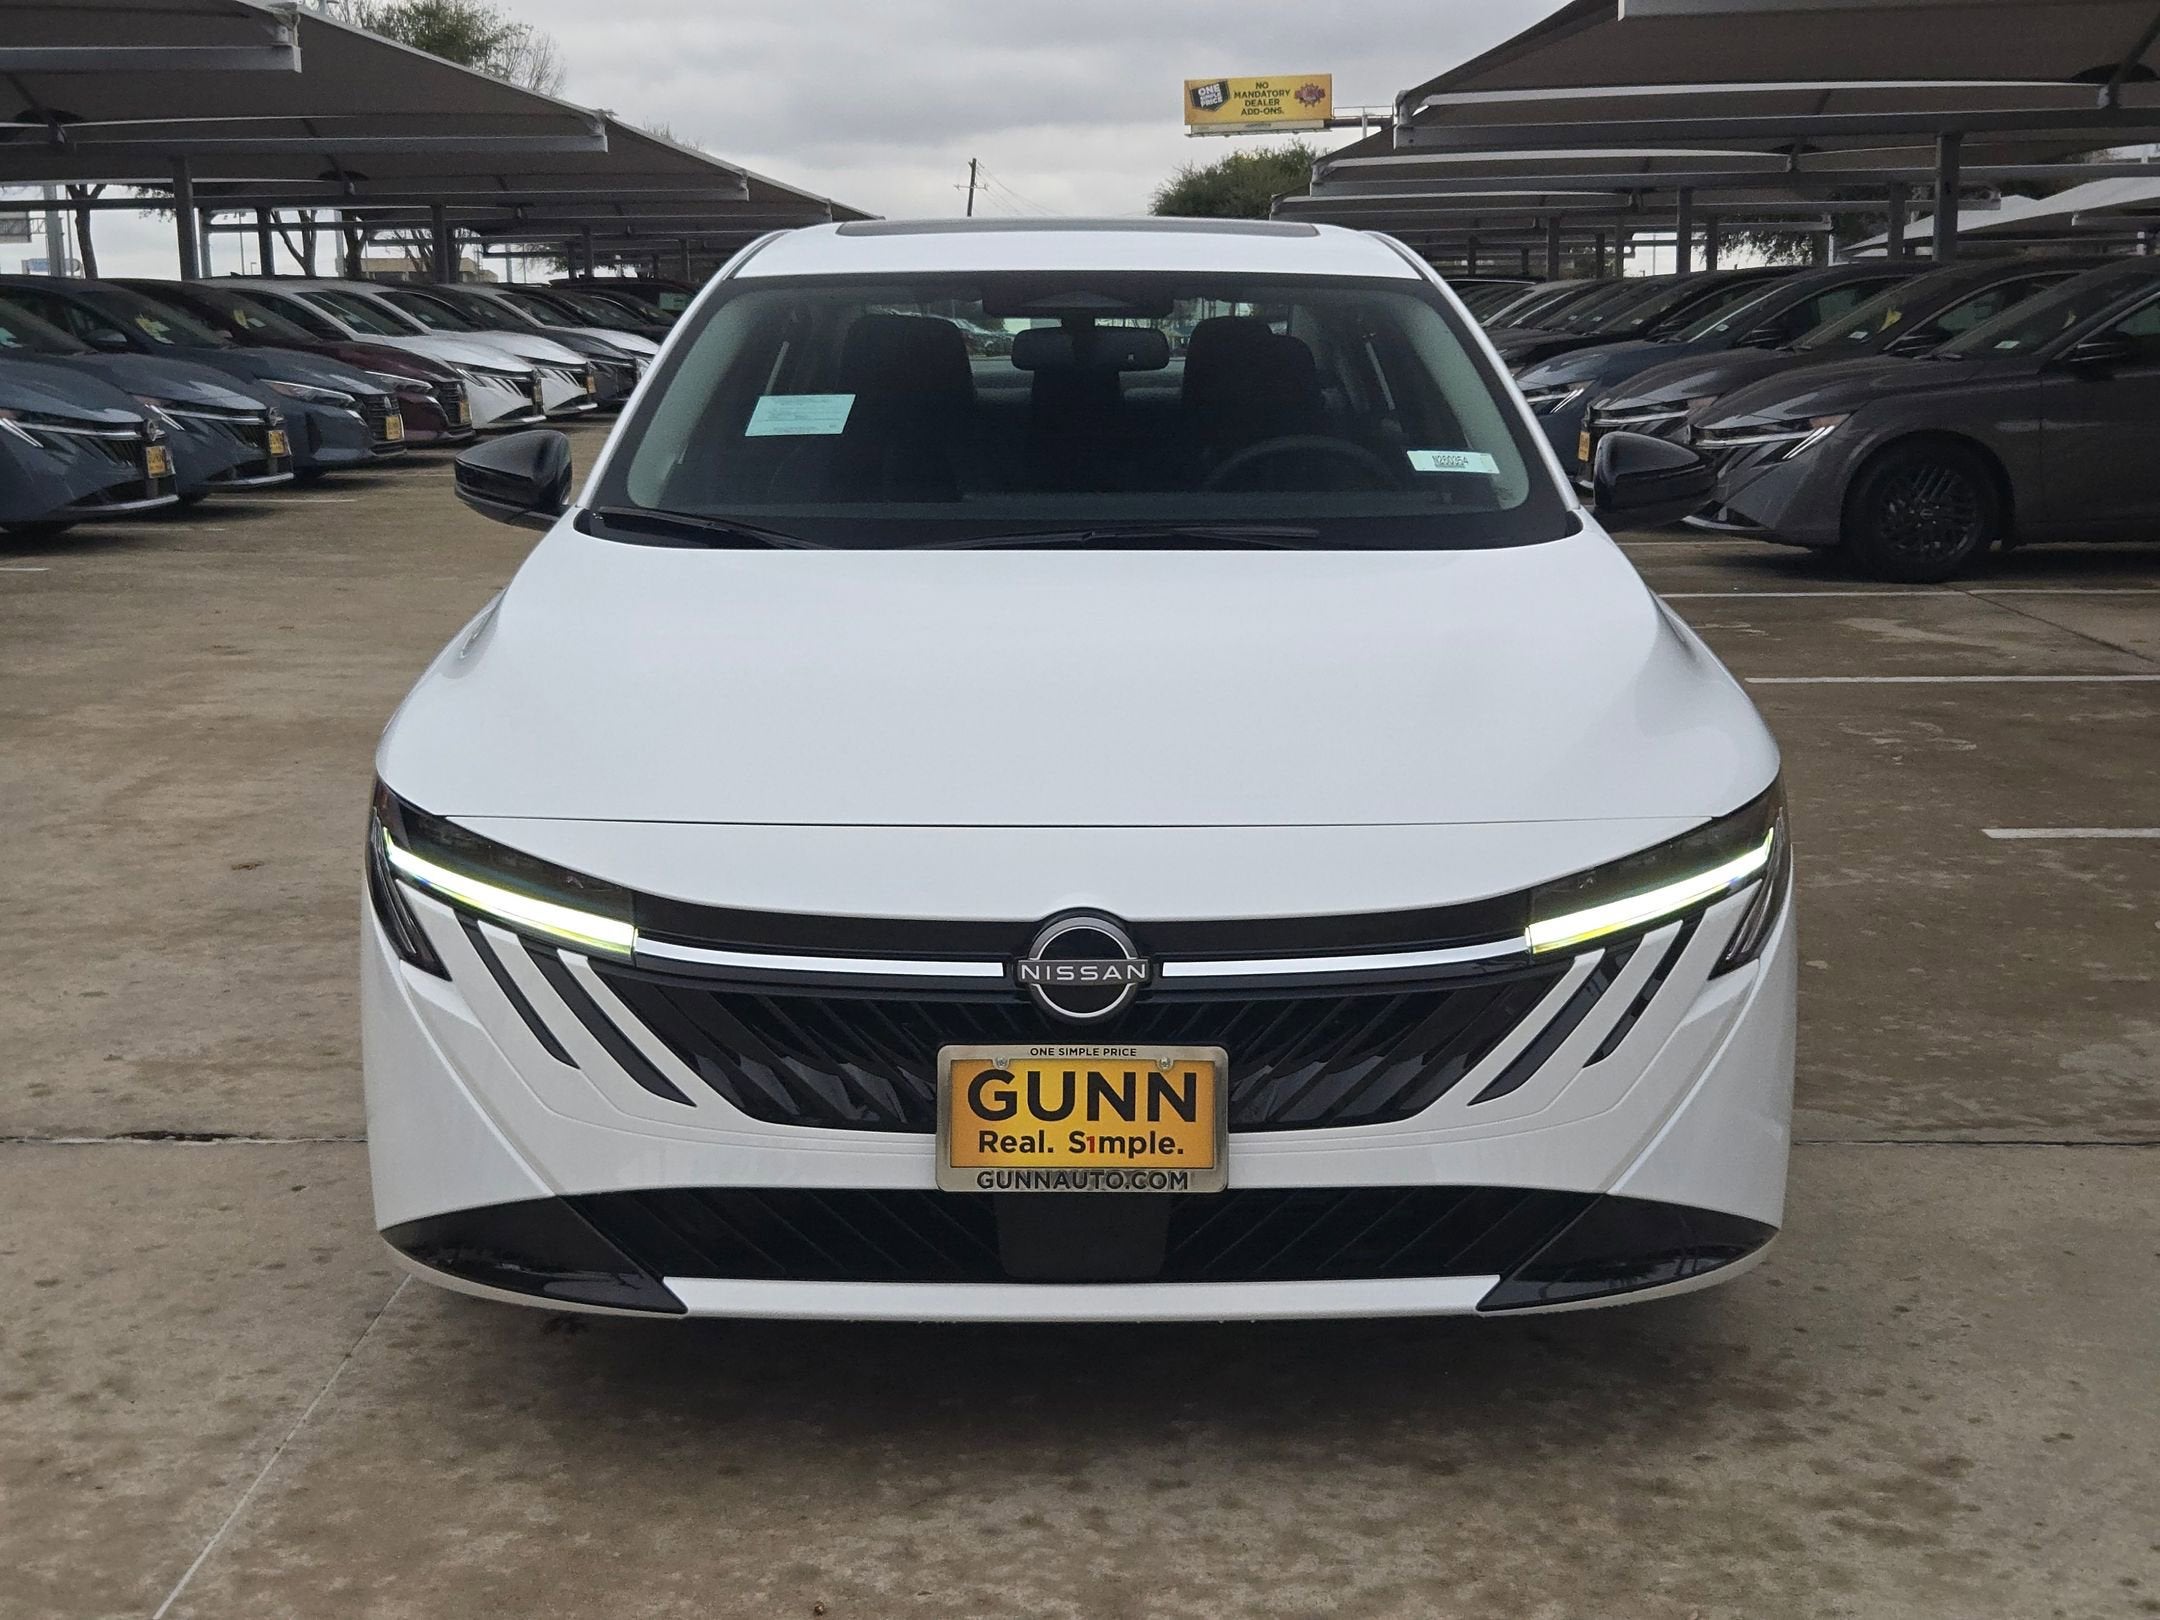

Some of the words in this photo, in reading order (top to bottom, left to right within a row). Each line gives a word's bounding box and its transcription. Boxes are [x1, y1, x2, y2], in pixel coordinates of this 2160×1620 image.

[1198, 83, 1220, 96] ONE
[1255, 81, 1269, 90] NO
[1234, 89, 1290, 99] MANDATORY
[1200, 96, 1223, 108] PRICE
[1244, 98, 1280, 107] DEALER
[1241, 107, 1285, 116] ADD-ONS.
[1021, 964, 1146, 981] NISSAN
[1030, 1047, 1054, 1056] ONE
[1058, 1047, 1099, 1056] SIMPLE
[1103, 1047, 1137, 1057] PRICE
[967, 1069, 1197, 1123] GUNN
[979, 1130, 1054, 1154] Real.
[976, 1171, 1188, 1190] GUNNAUTO.COM
